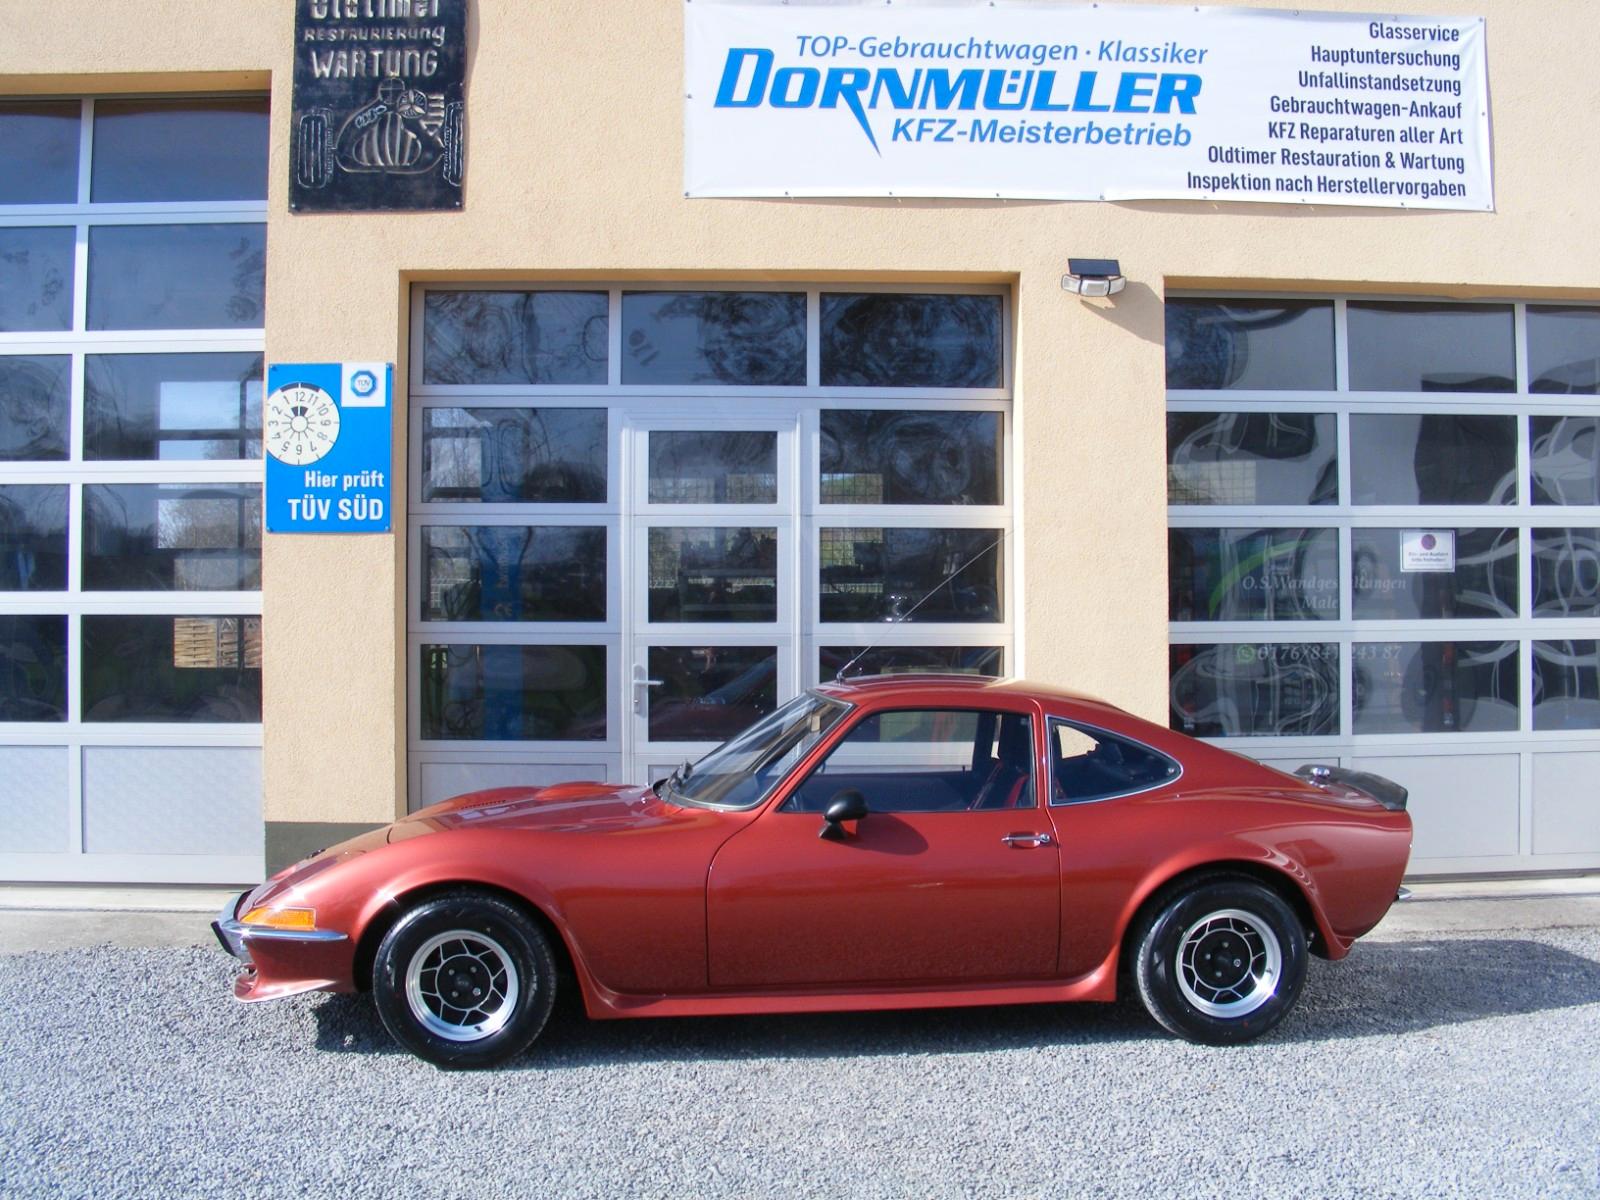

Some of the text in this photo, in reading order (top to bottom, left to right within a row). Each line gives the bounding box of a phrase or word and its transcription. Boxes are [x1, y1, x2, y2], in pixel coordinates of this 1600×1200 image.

[1369, 22, 1459, 41] Glasservice
[796, 35, 1207, 65] TOP-Gebrauchtwagen Klassiker
[1311, 46, 1460, 70] Hauptuntersuchung
[1298, 71, 1461, 96] Unfallinstandsetzung
[1270, 95, 1462, 119] Gebrauchtwagen-Ankauf
[891, 118, 1192, 147] KFZ-Meisterbetrieb
[1268, 121, 1463, 145] KFZ Reparaturen aller Art
[1208, 146, 1465, 173] Oldtimer Restauration & Wartung
[1187, 172, 1466, 199] Inspektion nach Herstellervorgaben
[295, 391, 306, 402] 12
[307, 394, 319, 406] 11
[317, 403, 329, 417] 10
[305, 470, 384, 491] Hier prüft
[288, 494, 384, 521] TÜV SÜD
